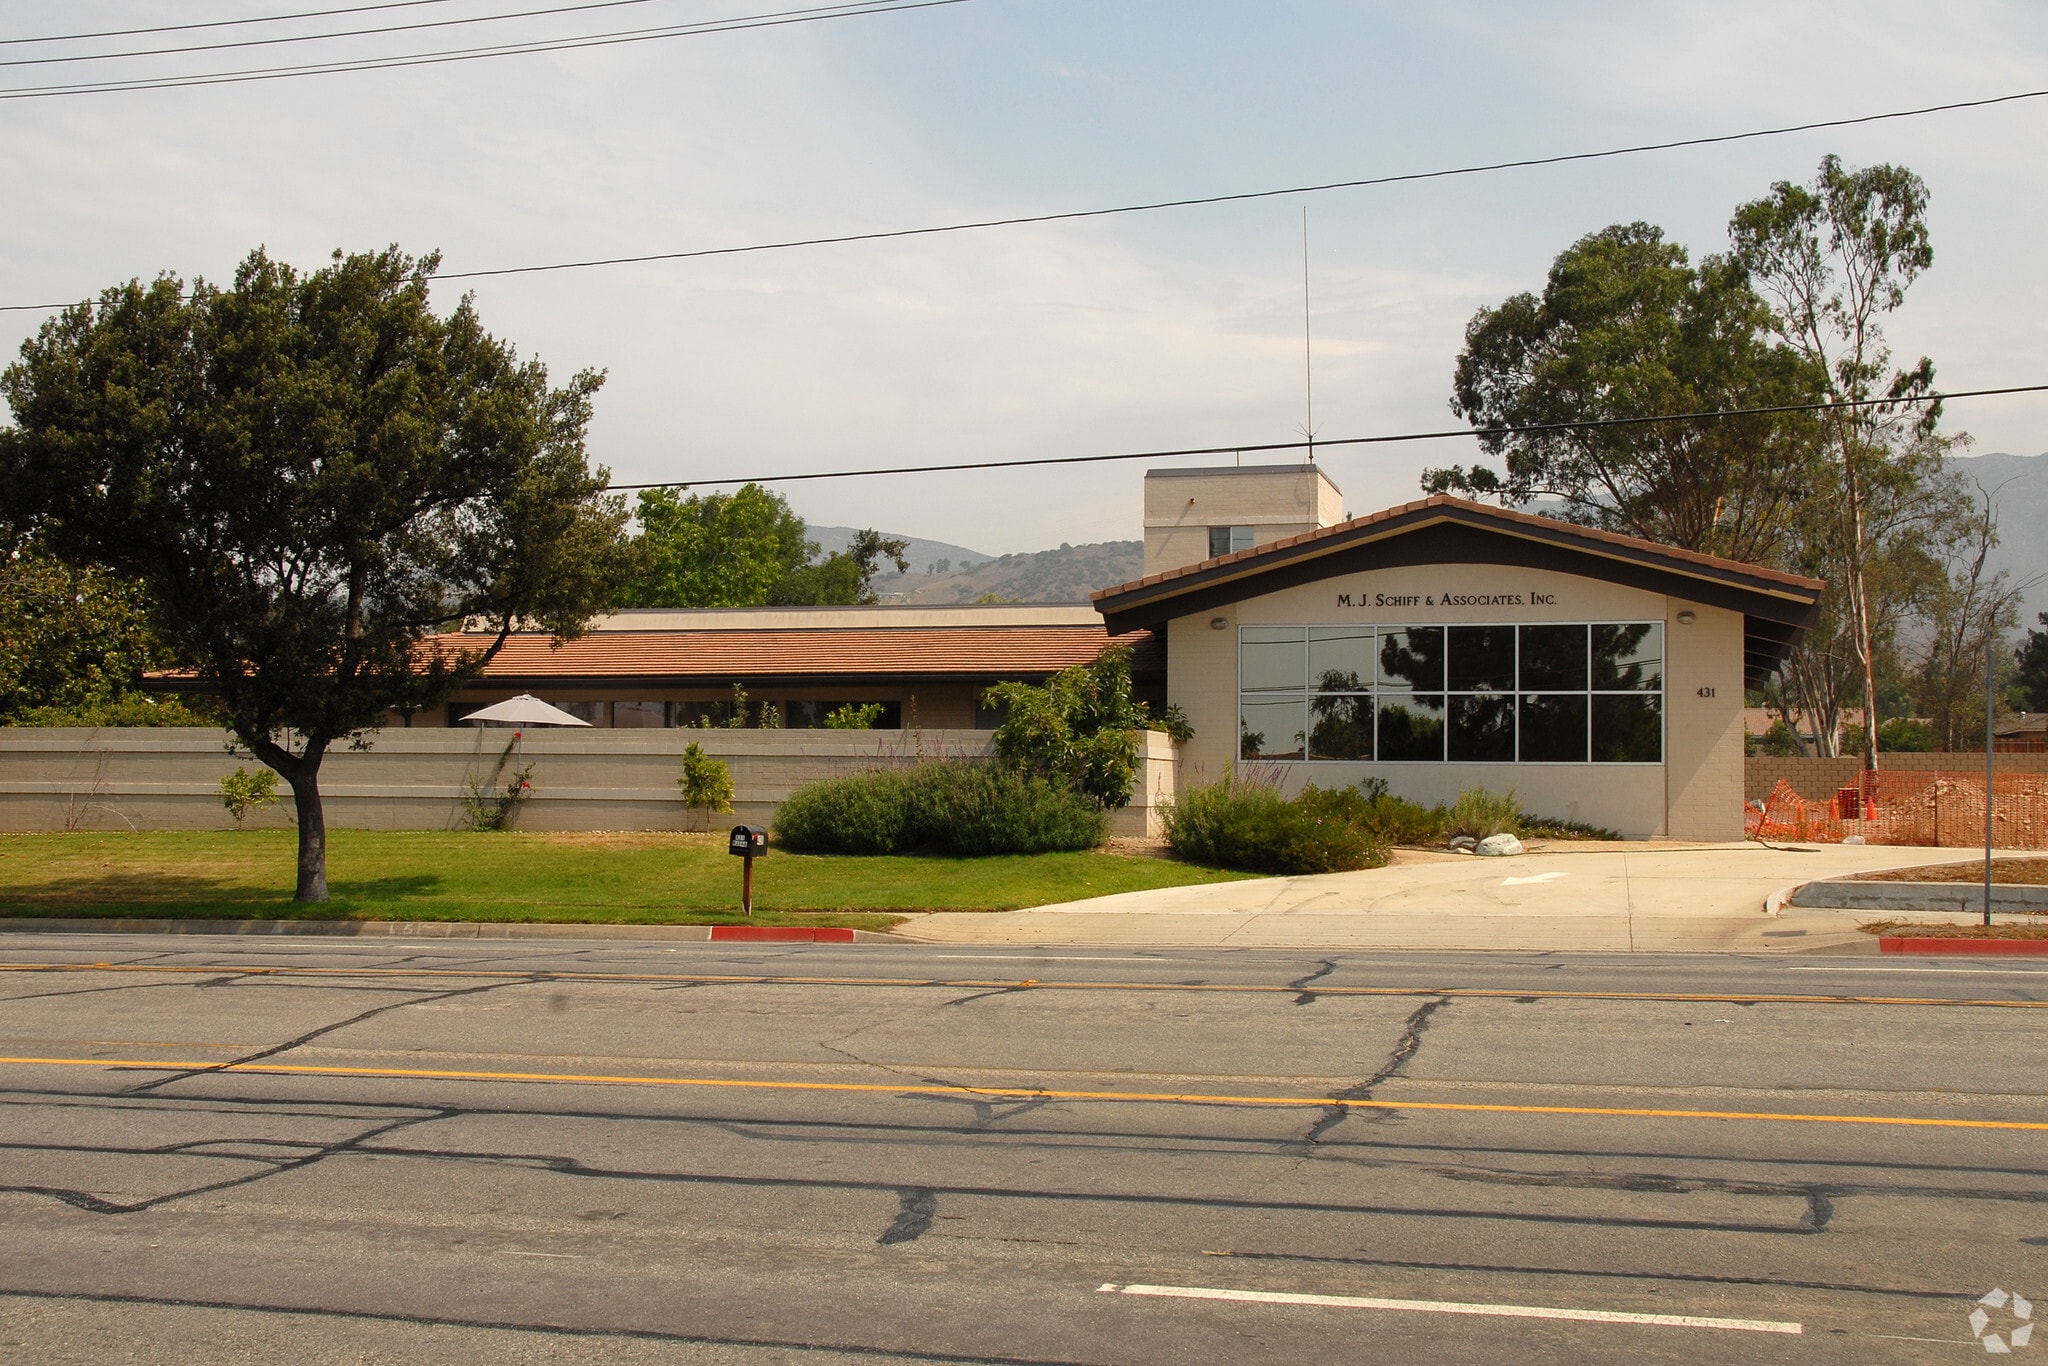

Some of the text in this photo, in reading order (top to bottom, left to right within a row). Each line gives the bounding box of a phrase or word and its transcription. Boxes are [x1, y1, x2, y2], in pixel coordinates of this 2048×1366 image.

[1337, 594, 1355, 607] M.
[1358, 594, 1371, 607] J.
[1375, 593, 1420, 607] SCHIFF
[1425, 596, 1434, 606] &
[1530, 592, 1557, 605] INC.
[1696, 687, 1715, 698] 431
